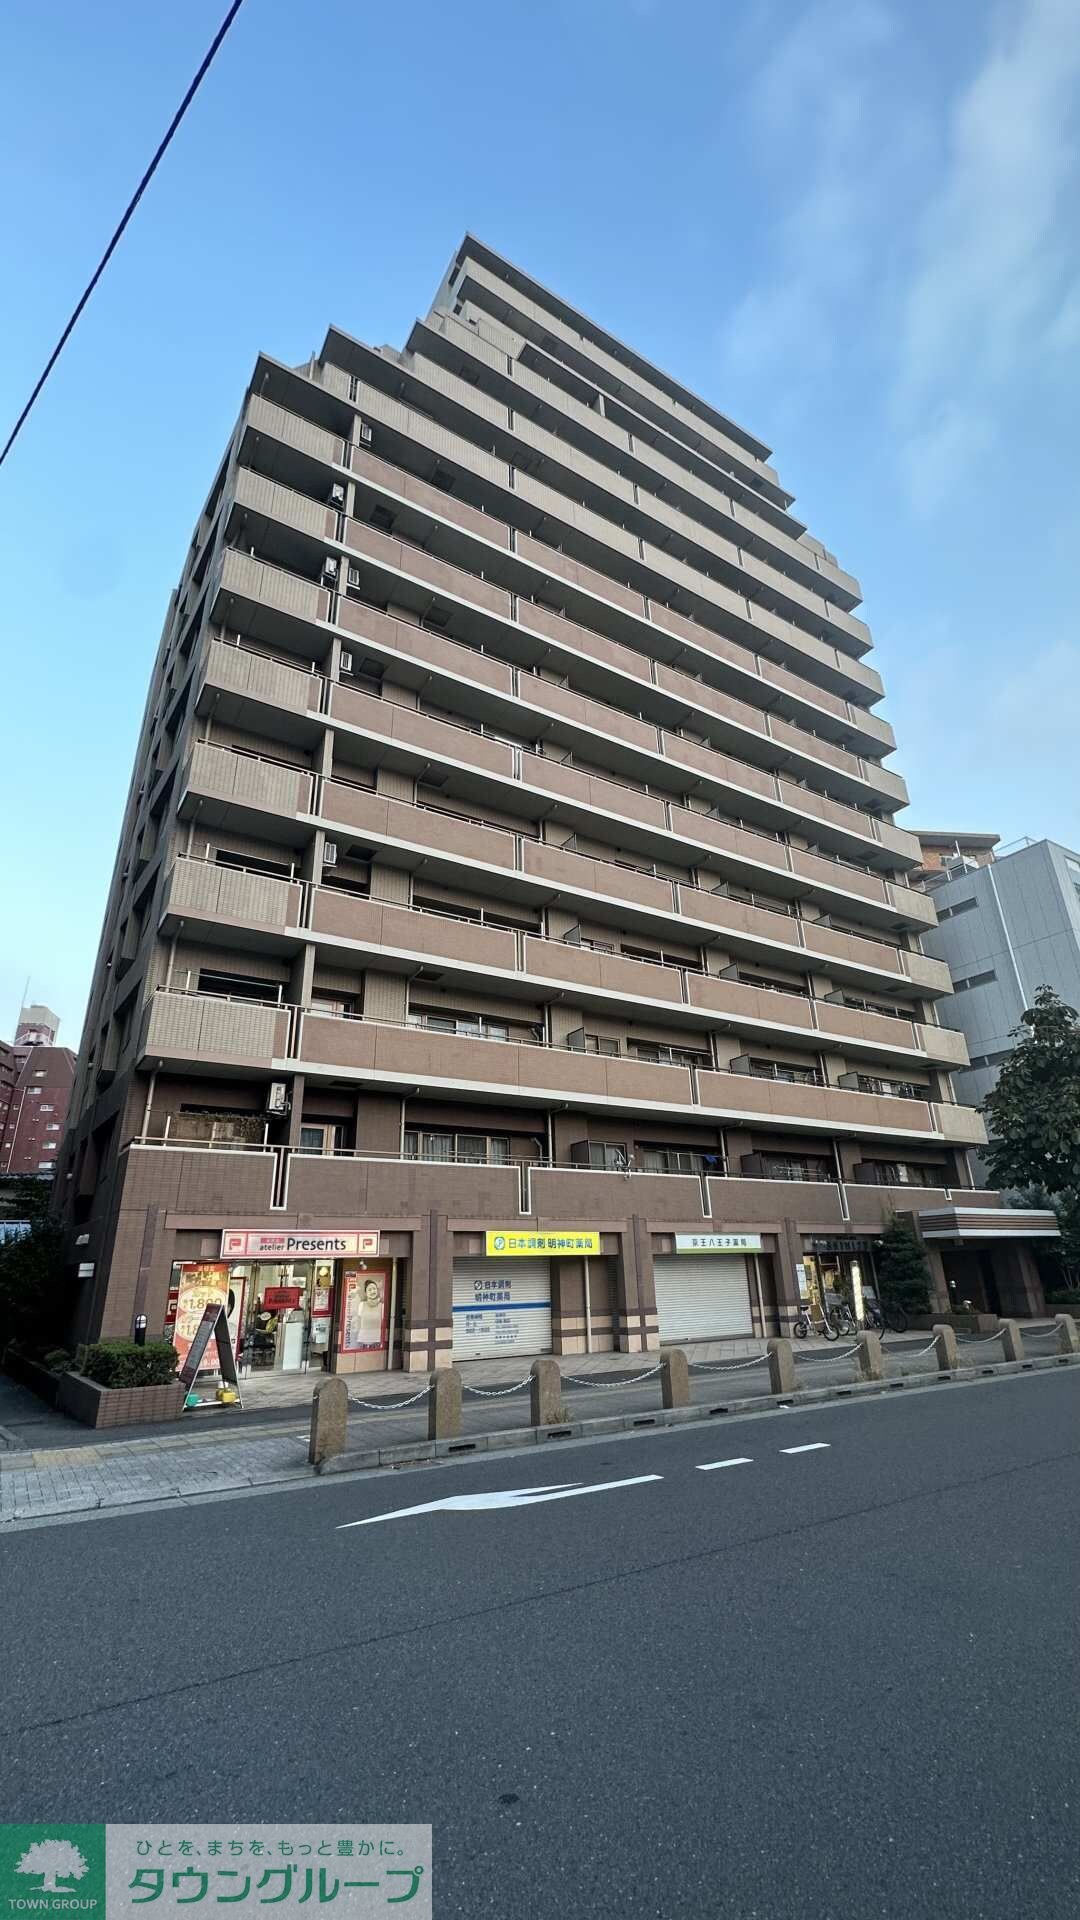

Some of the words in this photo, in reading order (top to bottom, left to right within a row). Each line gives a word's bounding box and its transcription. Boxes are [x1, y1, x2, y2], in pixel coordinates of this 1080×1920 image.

[259, 1243, 285, 1251] atelier
[287, 1237, 347, 1251] Presents
[691, 1238, 747, 1248] 京王八王子薬局
